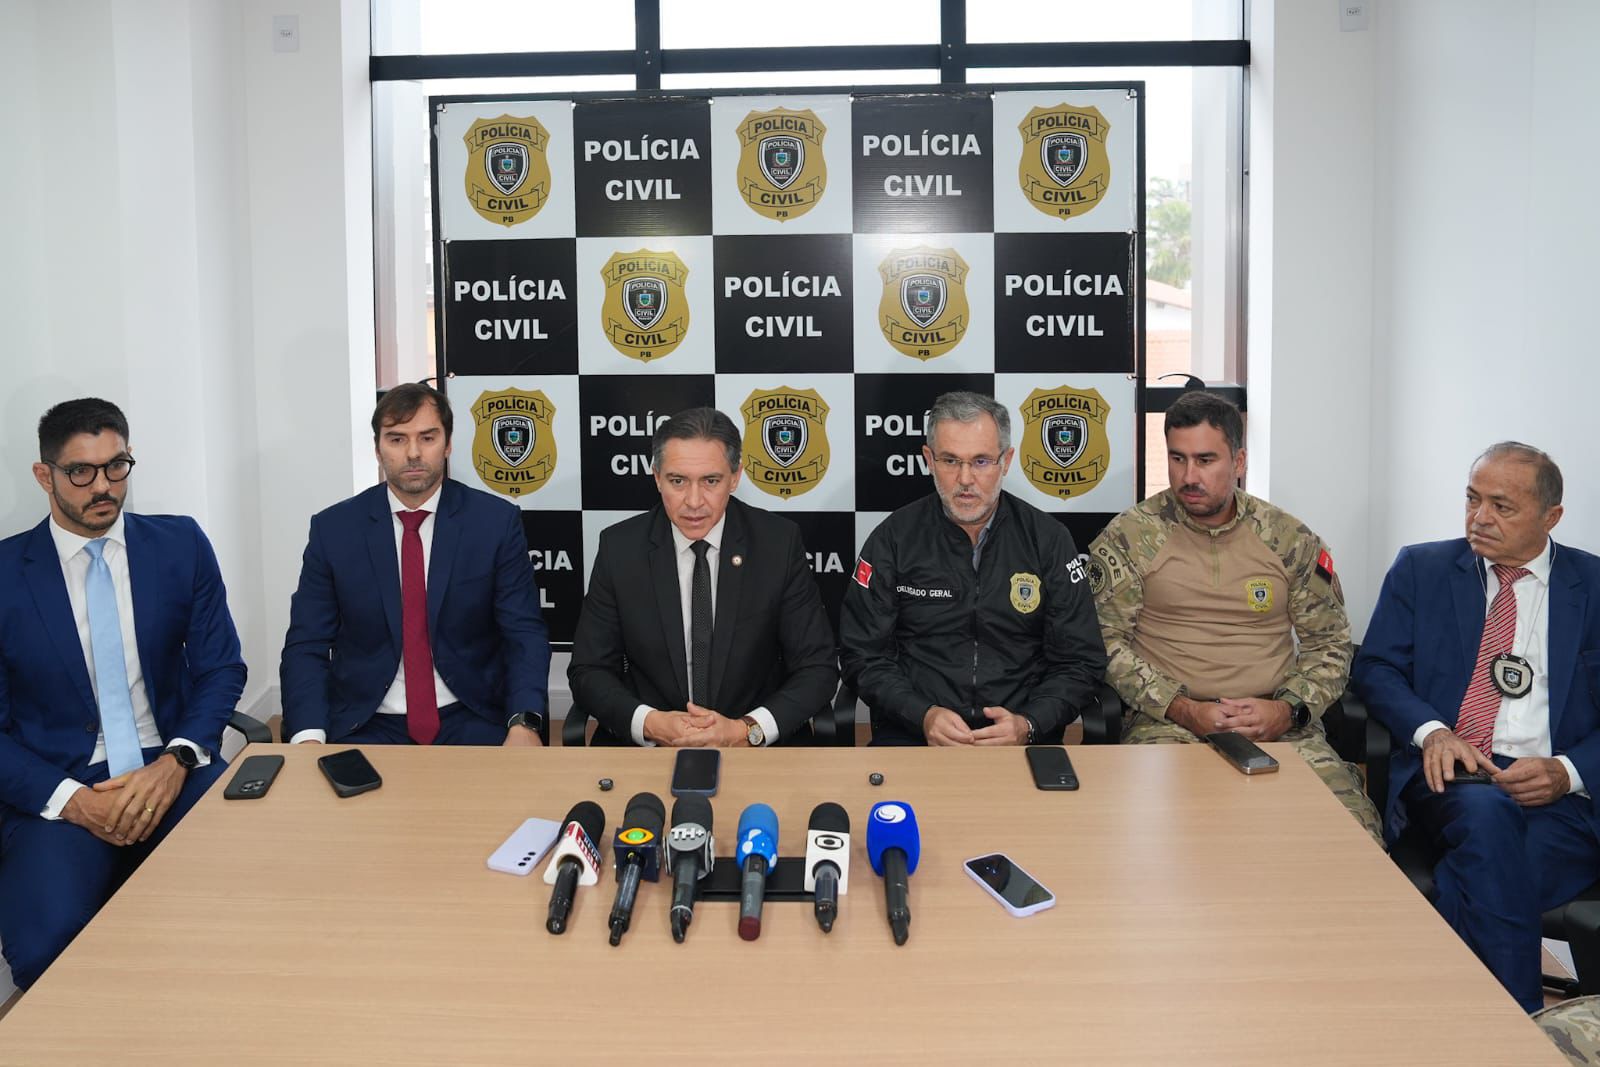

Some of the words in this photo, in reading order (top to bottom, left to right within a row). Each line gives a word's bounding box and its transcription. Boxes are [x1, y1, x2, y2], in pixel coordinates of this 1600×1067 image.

[755, 116, 807, 133] POLÍCIA
[1038, 112, 1090, 129] POLÍCIA
[482, 123, 531, 140] POLÍCIA
[584, 135, 700, 161] POLÍCIA
[863, 130, 982, 156] POLÍCIA
[605, 179, 681, 201] CIVIL
[884, 174, 962, 197] CIVIL
[488, 199, 528, 210] CIVIL
[761, 193, 803, 204] CIVIL
[1043, 191, 1086, 202] CIVIL
[619, 258, 670, 274] POLÍCIA
[454, 275, 567, 302] POLÍCIA
[724, 271, 842, 298] POLÍCIA
[1005, 269, 1124, 296] POLÍCIA
[474, 319, 549, 341] CIVIL
[745, 315, 823, 338] CIVIL
[1026, 315, 1104, 337] CIVIL
[625, 334, 667, 345] CIVIL
[902, 332, 945, 343] CIVIL
[488, 396, 537, 412] POLÍCIA
[759, 394, 810, 411] POLÍCIA
[1039, 394, 1091, 411] POLÍCIA
[590, 410, 672, 437] POLÍ
[865, 410, 931, 436] POLÍ
[610, 454, 655, 475] CIV
[886, 454, 930, 476] CIV
[494, 470, 535, 481] CIVIL
[764, 470, 806, 482] CIVIL
[1043, 471, 1086, 482] CIVIL
[1098, 547, 1122, 580] GOE
[929, 589, 953, 598] GERAL
